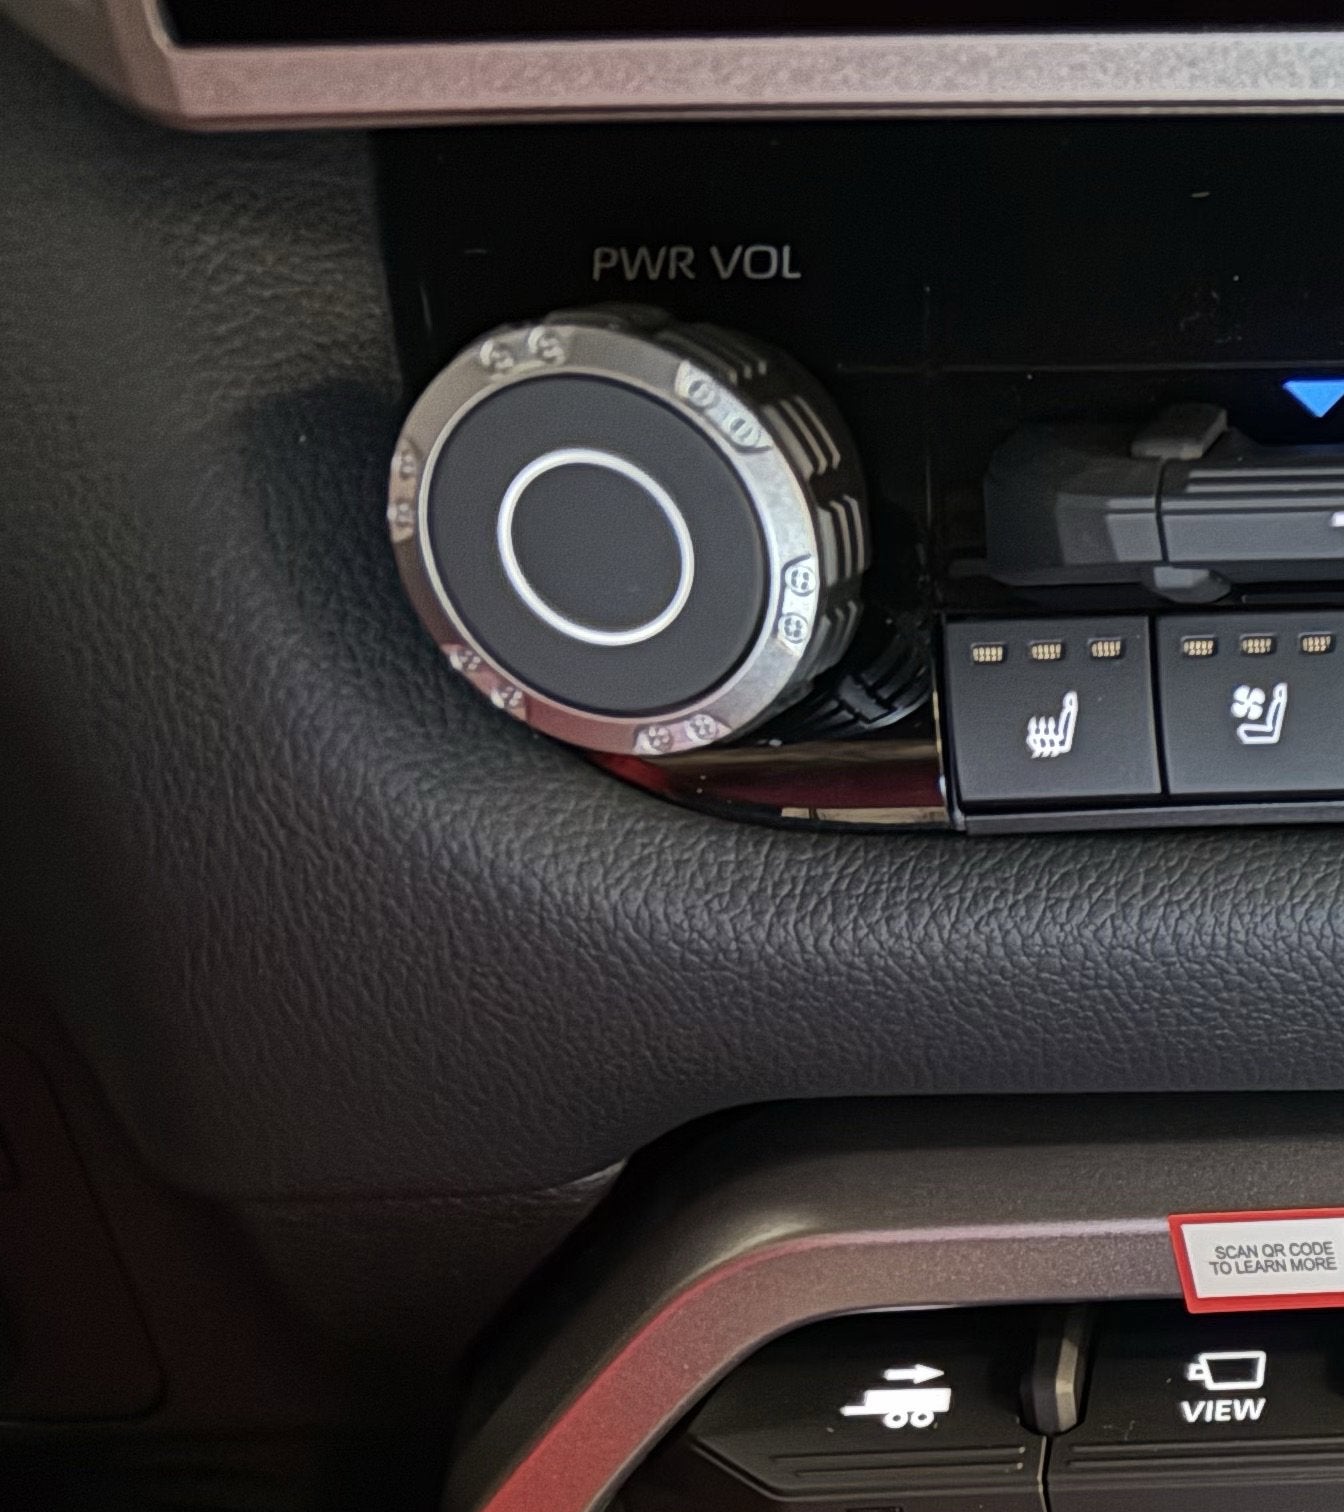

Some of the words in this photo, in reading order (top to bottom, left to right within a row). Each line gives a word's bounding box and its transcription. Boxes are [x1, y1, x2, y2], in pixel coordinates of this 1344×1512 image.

[592, 245, 696, 282] PWR
[709, 244, 802, 280] VOL
[1214, 1244, 1259, 1260] SCAN
[1261, 1243, 1287, 1258] QR
[1288, 1241, 1335, 1257] CODE
[1208, 1260, 1232, 1275] TO
[1234, 1259, 1288, 1275] LEARN
[1289, 1256, 1338, 1272] MORE
[1180, 1398, 1266, 1423] VIEW
